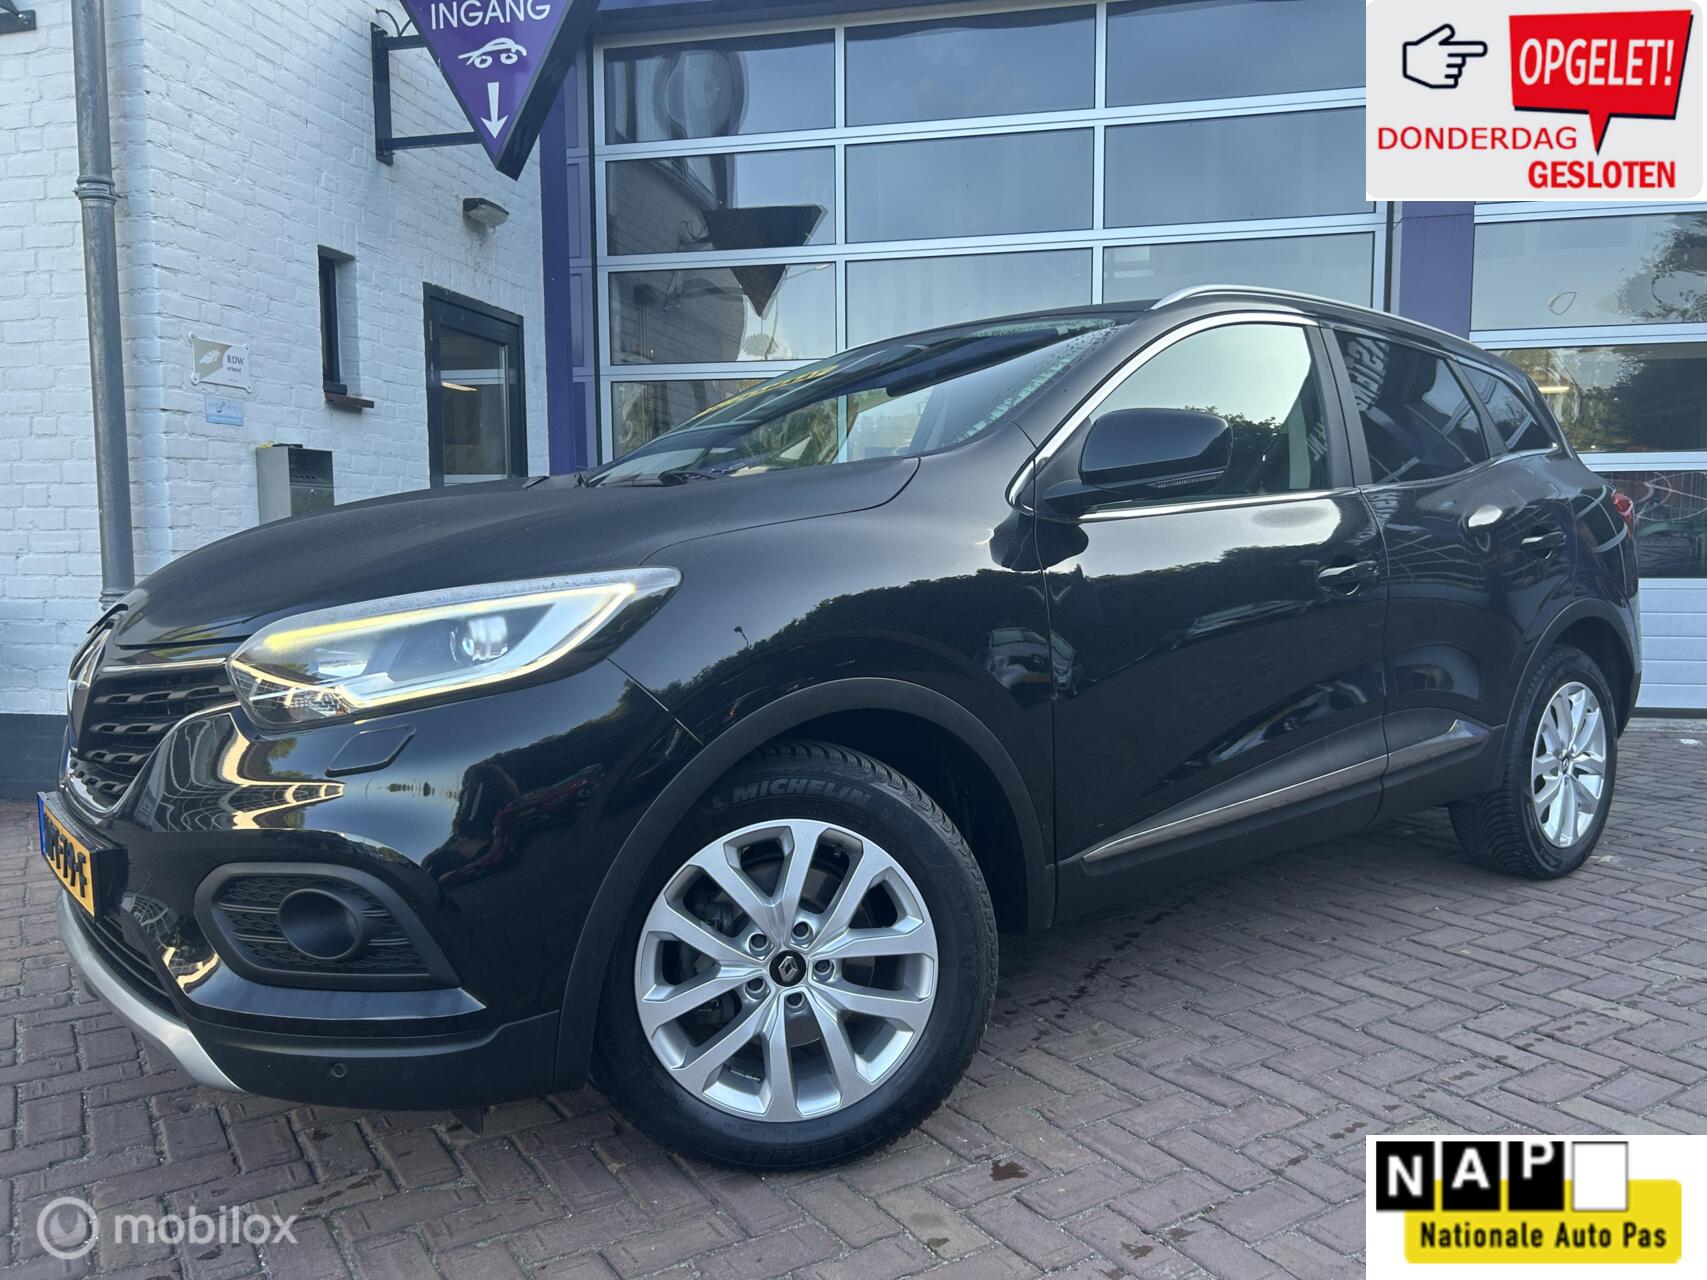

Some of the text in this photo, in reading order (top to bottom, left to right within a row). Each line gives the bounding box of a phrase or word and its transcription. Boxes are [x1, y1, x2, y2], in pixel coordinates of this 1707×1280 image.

[431, 0, 551, 30] INGANG
[227, 355, 244, 365] RDW
[733, 778, 871, 805] MICHELIN
